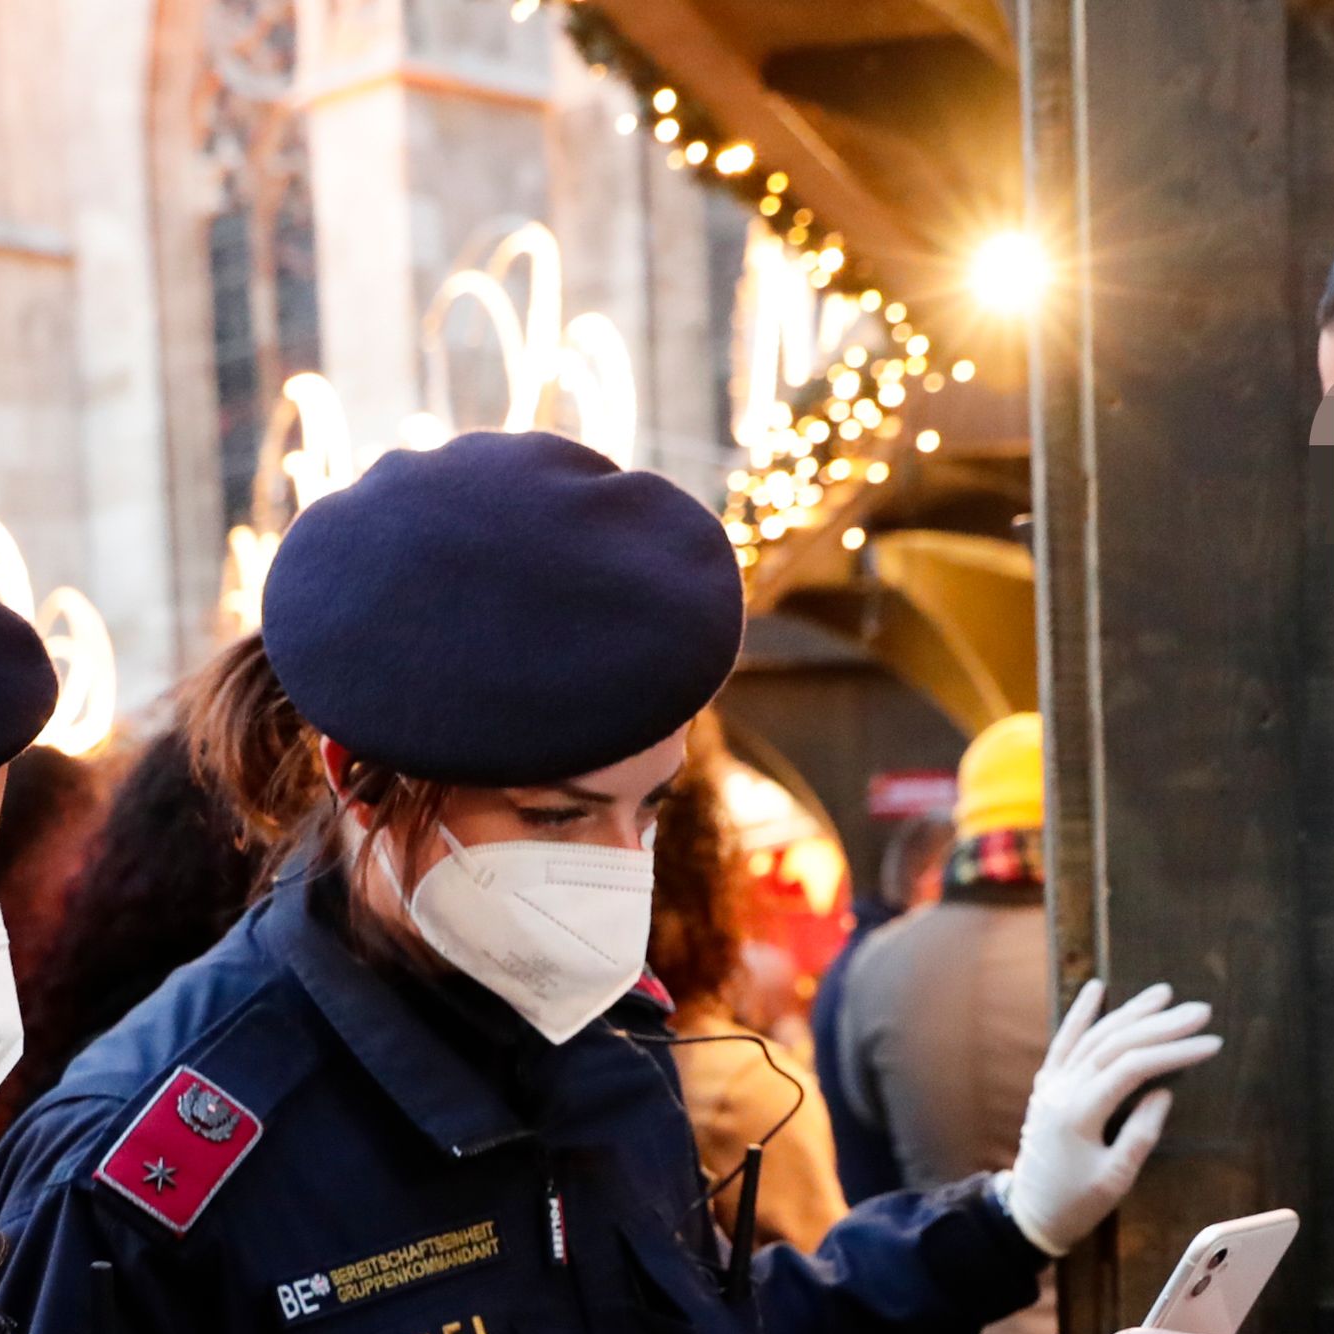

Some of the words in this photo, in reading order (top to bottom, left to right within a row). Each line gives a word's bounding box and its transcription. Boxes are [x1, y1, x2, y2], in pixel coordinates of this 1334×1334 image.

[277, 1277, 320, 1320] BE
[329, 1220, 495, 1286] BEREITSCHAFTSEINHEIT
[336, 1237, 500, 1304] GRUPPENKOMMANDANT
